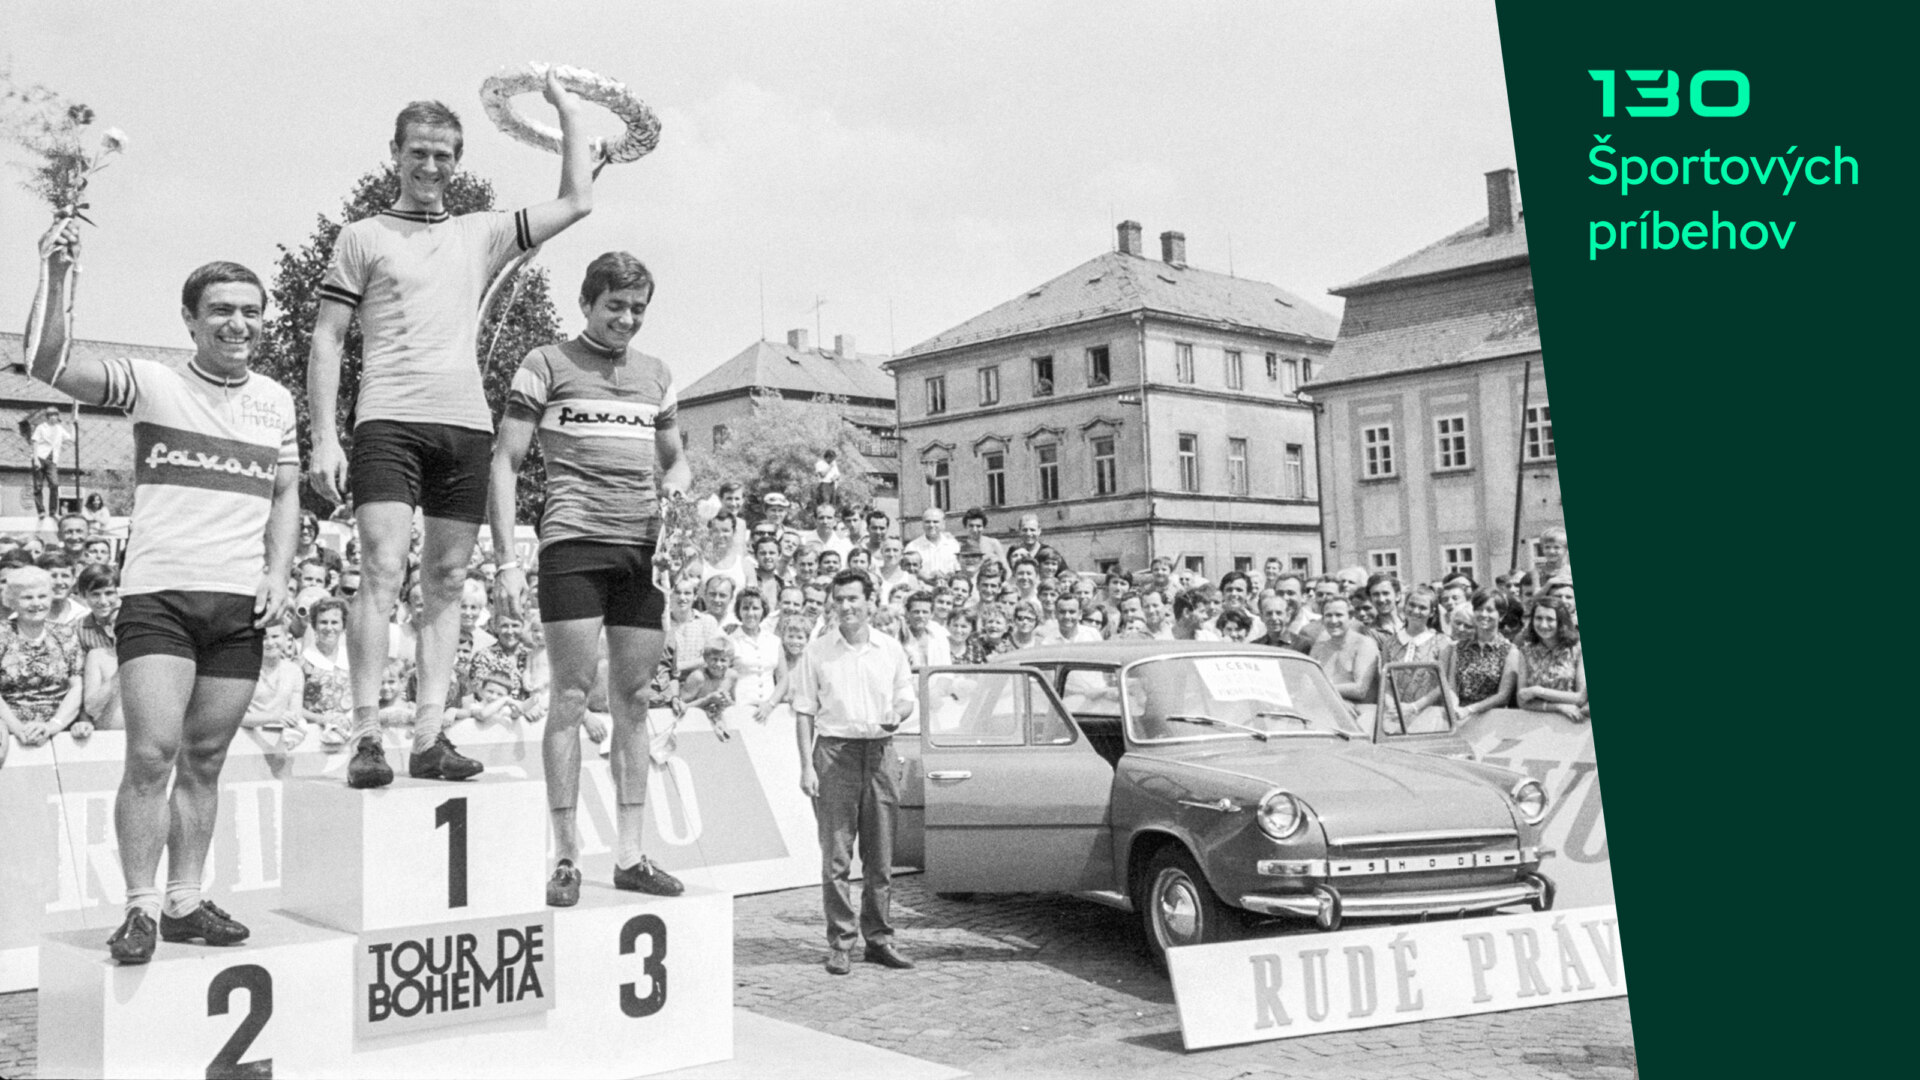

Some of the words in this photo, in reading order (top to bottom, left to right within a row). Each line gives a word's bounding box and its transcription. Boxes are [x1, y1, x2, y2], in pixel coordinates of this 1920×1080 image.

[435, 797, 468, 909] 1
[368, 933, 478, 985] TOUR
[497, 925, 544, 968] DE
[368, 961, 544, 1023] BOHEMIA
[619, 913, 667, 1018] 3
[1249, 931, 1425, 1031] RUDÉ
[205, 964, 273, 1080] 2
